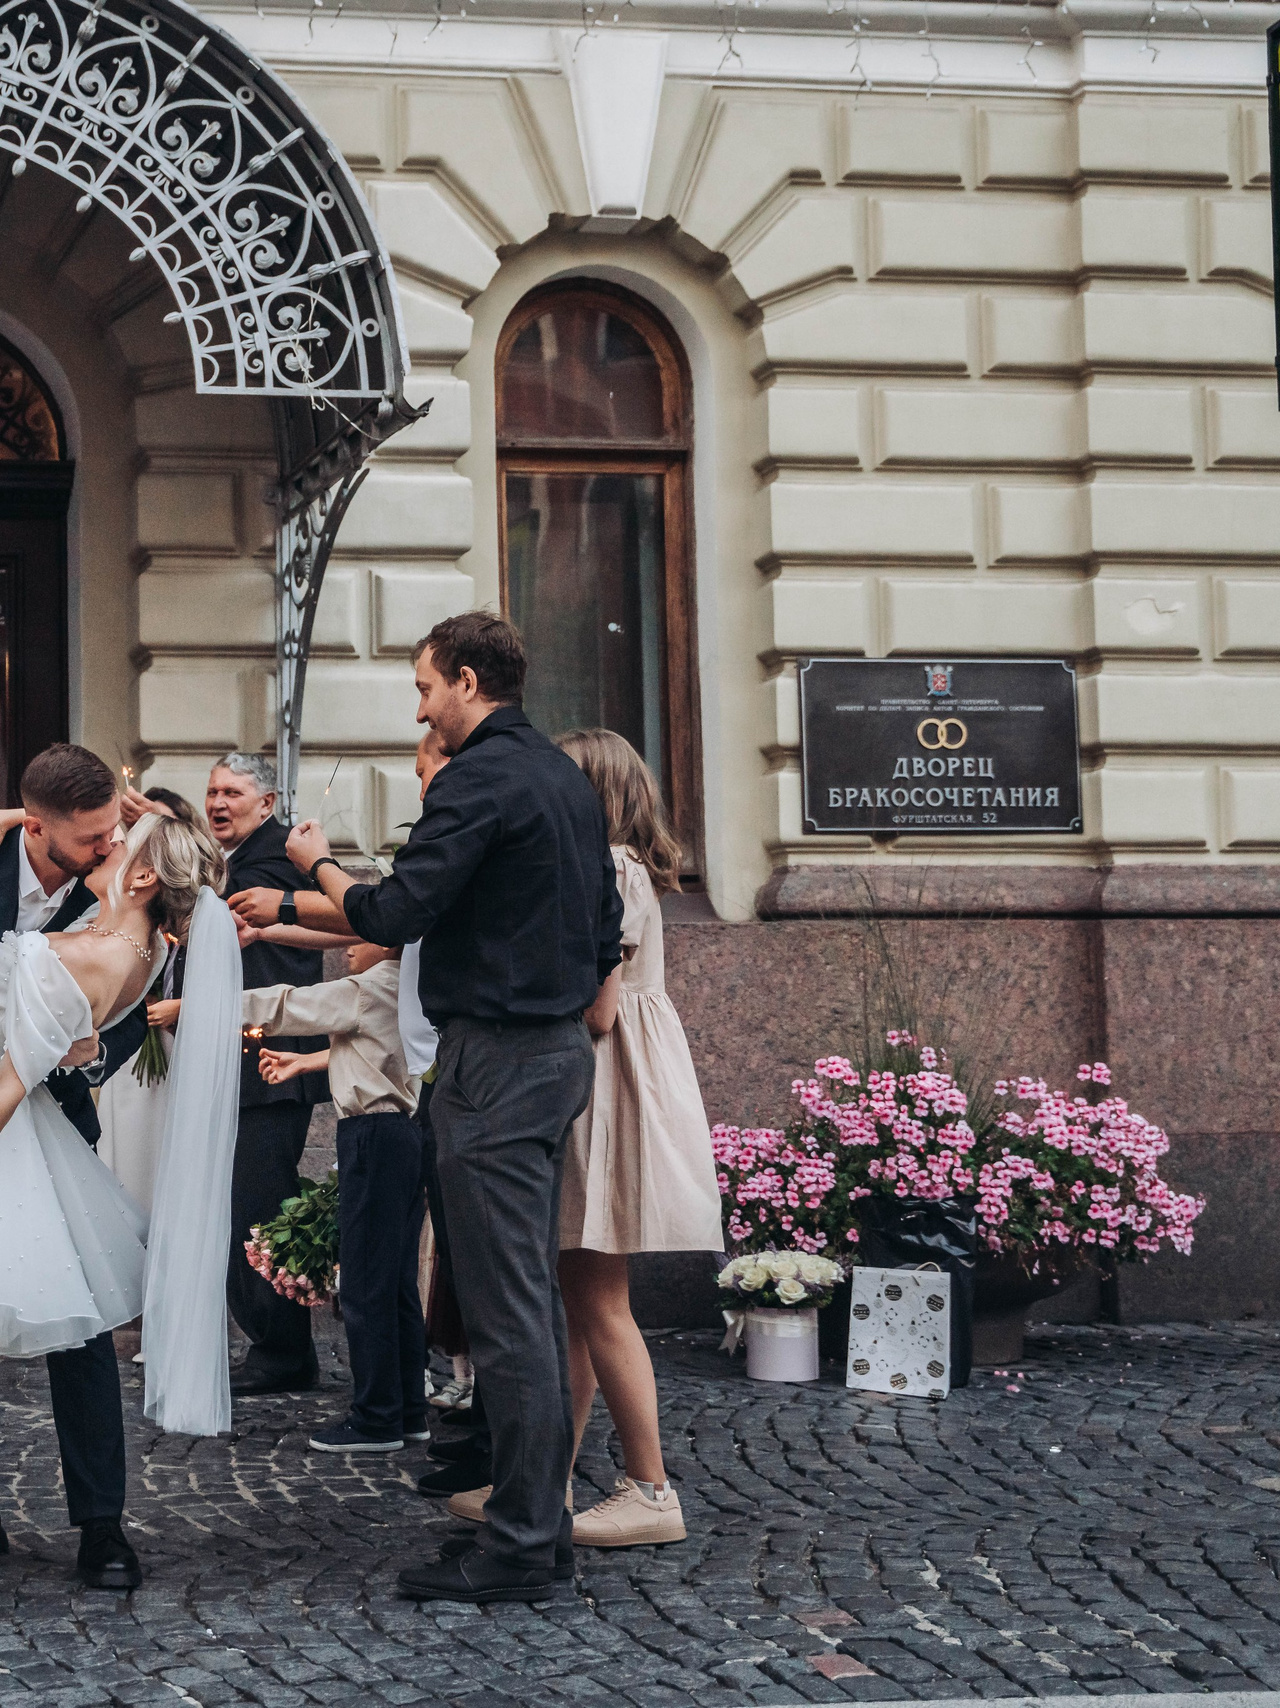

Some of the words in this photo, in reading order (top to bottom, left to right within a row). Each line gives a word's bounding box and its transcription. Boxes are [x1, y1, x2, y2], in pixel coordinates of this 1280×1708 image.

[892, 757, 996, 780] ДВОРЕЦ
[827, 787, 1061, 808] БРАКОСОЧЕТАНИЯ
[981, 813, 998, 823] 52
